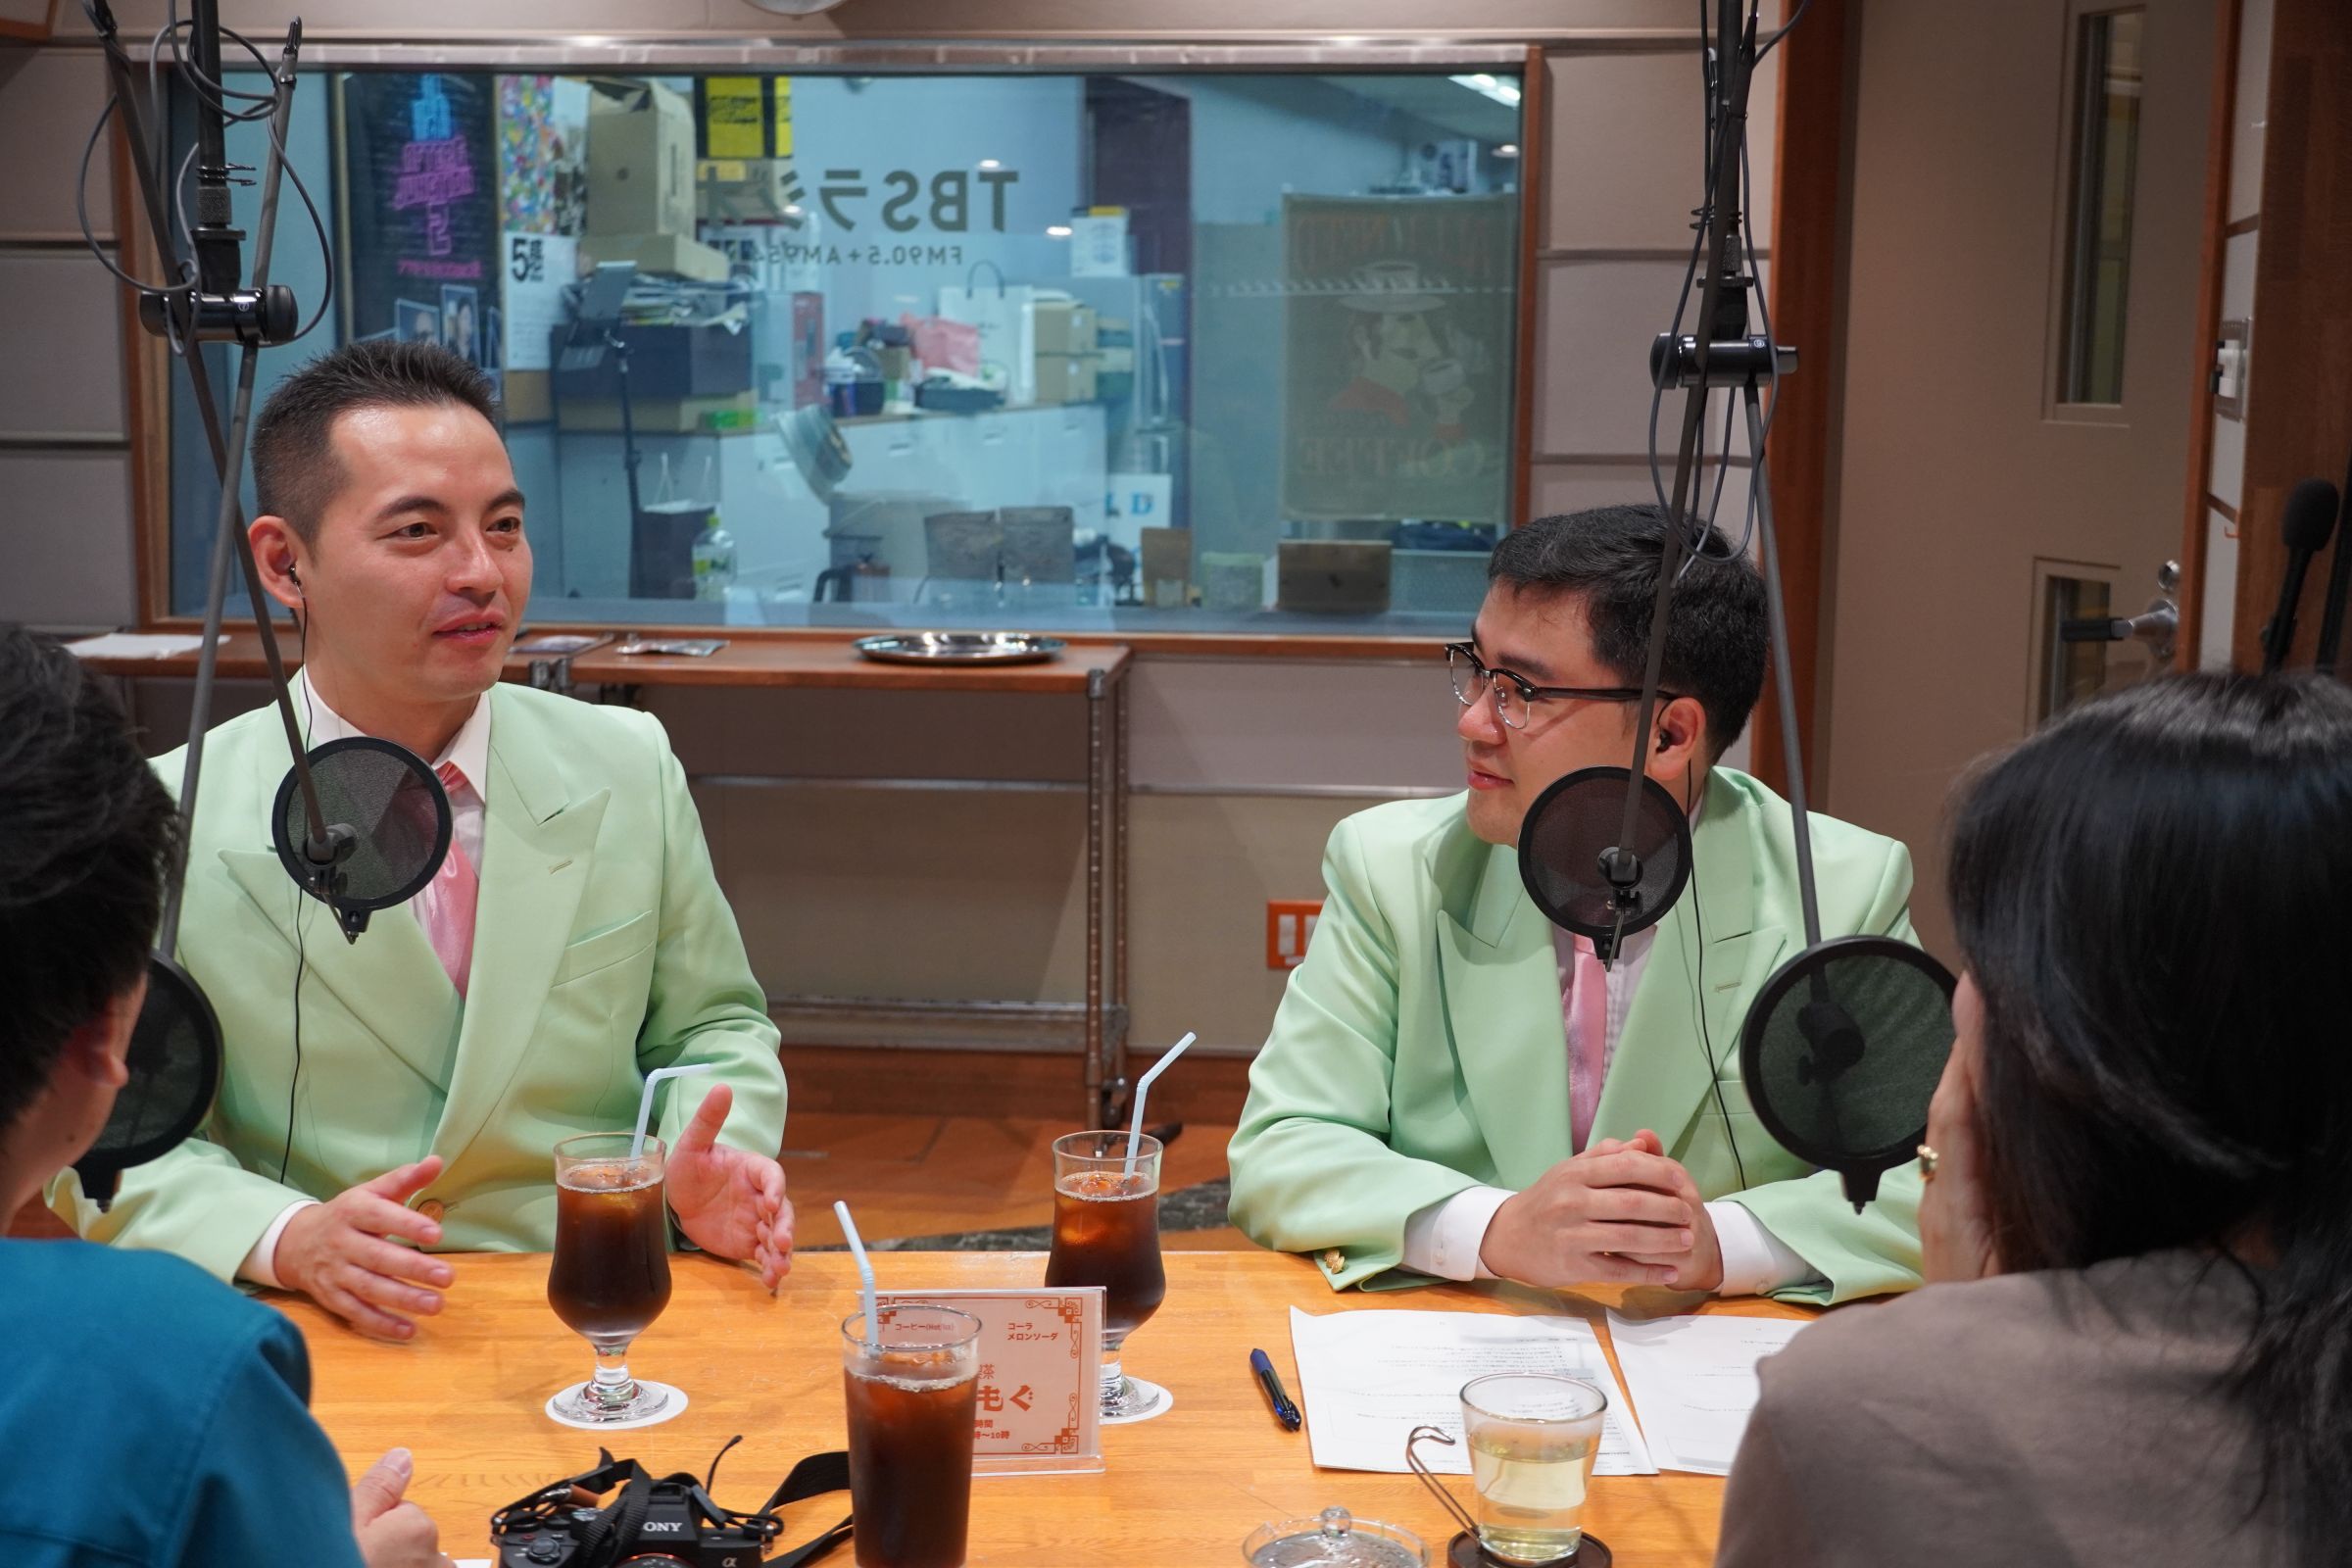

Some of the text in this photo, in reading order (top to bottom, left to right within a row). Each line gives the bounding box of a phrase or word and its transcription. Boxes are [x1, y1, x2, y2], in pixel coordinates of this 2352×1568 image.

[1007, 1322, 1033, 1331] コーラ
[1007, 1332, 1058, 1341] メロンソーダ
[642, 1521, 683, 1532] ONY
